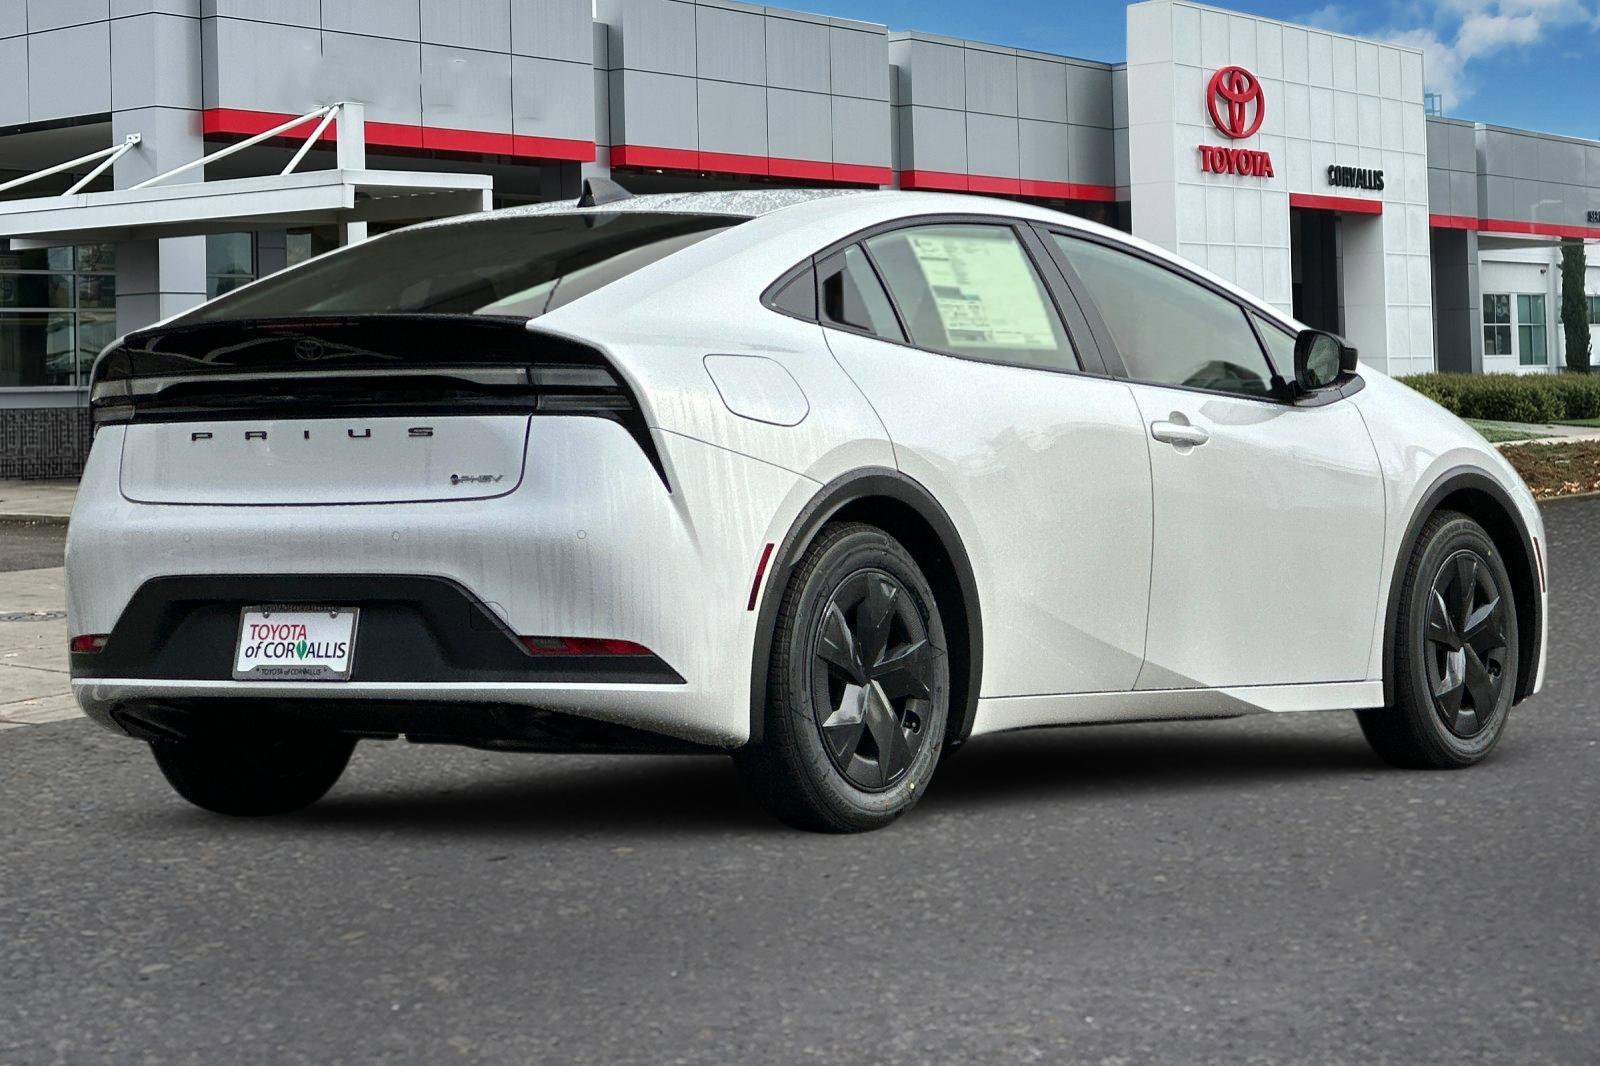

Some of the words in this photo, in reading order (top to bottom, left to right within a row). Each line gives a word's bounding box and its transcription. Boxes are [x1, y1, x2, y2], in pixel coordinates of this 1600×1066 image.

[1198, 144, 1275, 178] TOYOTA
[1327, 164, 1385, 191] CORVALLIS
[191, 427, 434, 442] PRIUS
[249, 624, 307, 641] TOYOTA
[244, 641, 264, 659] of
